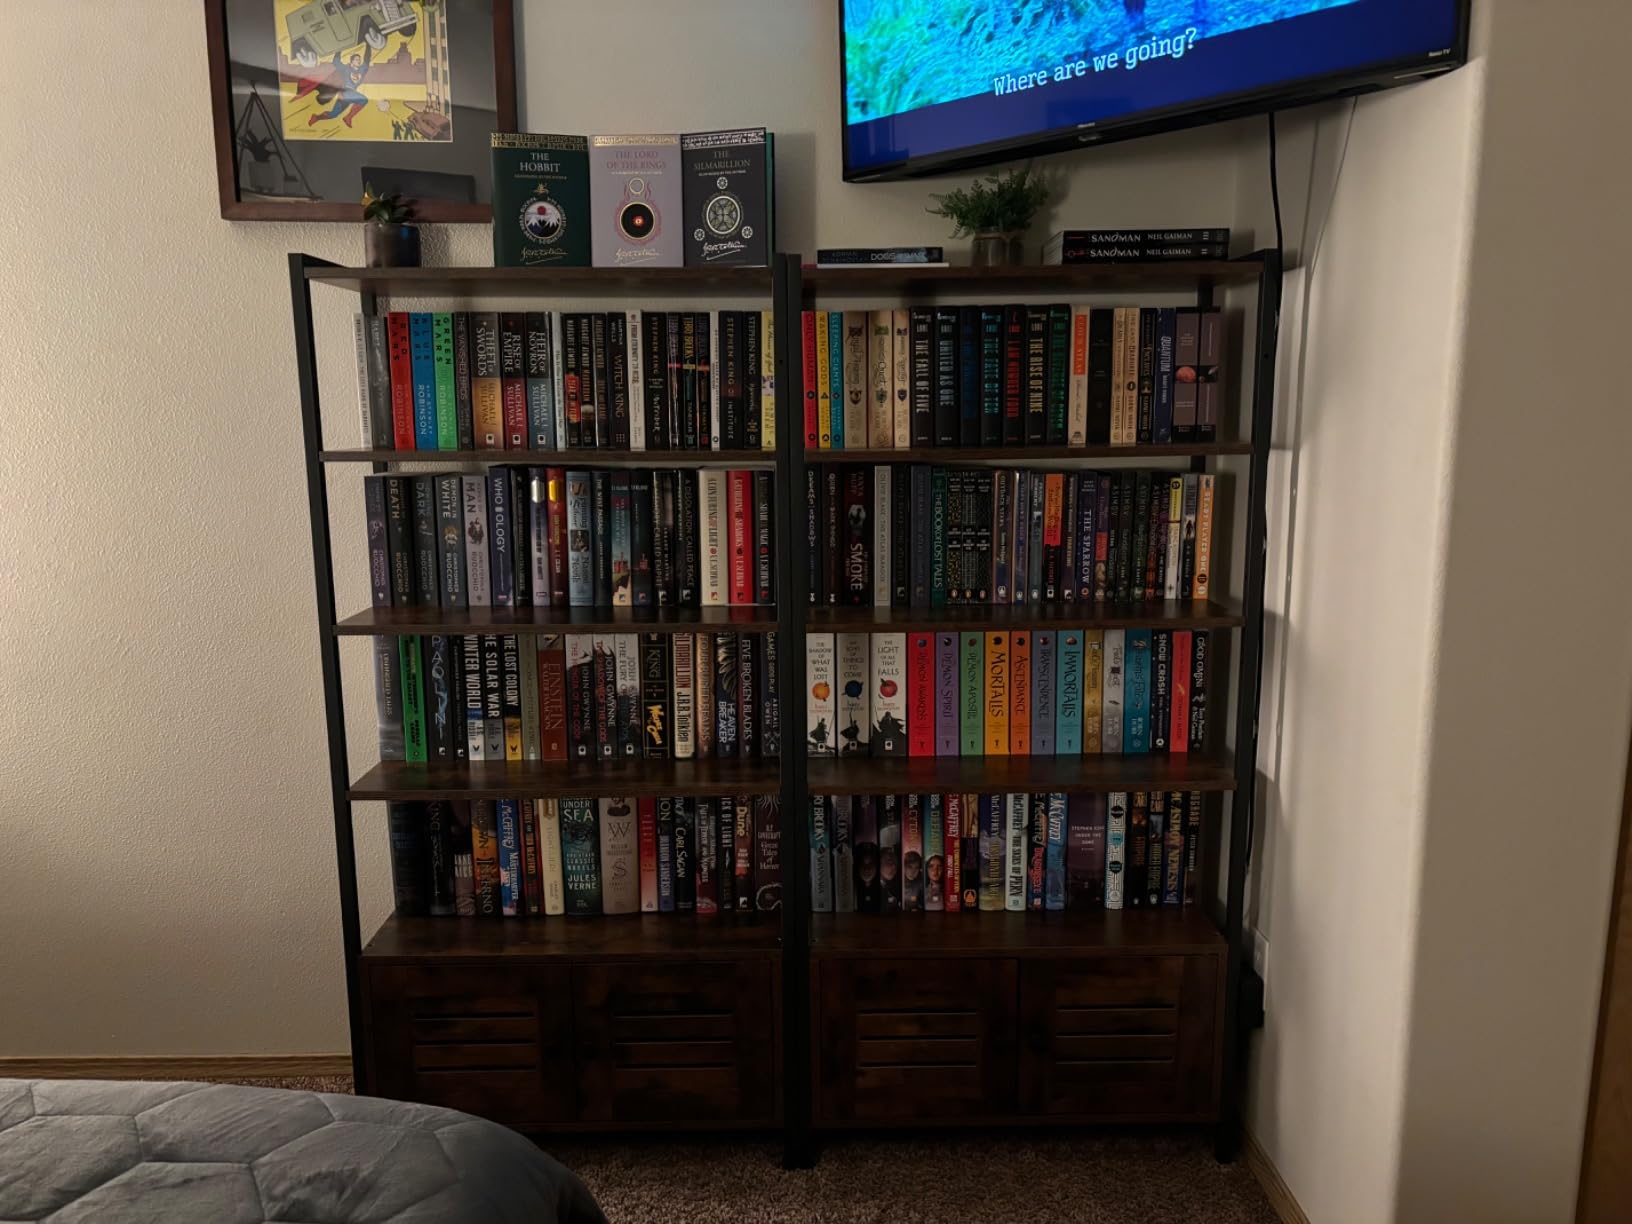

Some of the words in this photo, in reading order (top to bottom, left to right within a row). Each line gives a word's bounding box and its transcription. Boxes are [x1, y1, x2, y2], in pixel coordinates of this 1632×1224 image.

[994, 72, 1048, 96] Where
[1053, 59, 1086, 79] are
[1093, 52, 1119, 72] we
[1125, 27, 1198, 70] going?
[520, 162, 560, 172] HOBBIT
[531, 152, 549, 160] THE
[607, 161, 619, 169] OF
[621, 161, 636, 169] THE
[640, 161, 667, 169] RINGS
[615, 150, 632, 158] THE
[635, 150, 657, 158] LORD
[694, 159, 750, 170] SILMARILLION
[1091, 234, 1141, 242] SANDMAN
[1090, 249, 1140, 257] SANDMAN
[443, 317, 451, 364] GREEN
[486, 329, 495, 365] THEFT
[512, 335, 520, 358] RISE
[536, 332, 546, 360] HEIR
[831, 314, 839, 354] SLEEPING
[916, 339, 928, 356] THE
[984, 338, 998, 354] THE
[1030, 338, 1043, 354] THE
[476, 328, 487, 376] SWORDS
[503, 332, 513, 373] EMPIRE
[514, 359, 520, 369] OF
[528, 331, 537, 374] NOVRON
[940, 340, 953, 371] UNITED
[1160, 336, 1171, 372] QUANTUM
[539, 362, 545, 372] OF
[614, 355, 624, 389] WITCH
[916, 359, 928, 378] FALL
[940, 375, 953, 386] AS
[984, 359, 998, 378] FATE
[1030, 357, 1043, 376] RISE
[916, 381, 929, 391] OF
[940, 389, 954, 406] ONE
[985, 384, 998, 392] OF
[1030, 380, 1043, 390] OF
[418, 385, 426, 434] ROBINSON
[514, 384, 522, 422] MICHAEL
[532, 386, 540, 425] SULLIVAN
[615, 393, 624, 418] KING
[916, 395, 929, 413] FIVE
[985, 397, 998, 414] TEN
[1030, 392, 1043, 413] NINE
[389, 480, 400, 519] DEATH
[416, 482, 425, 517] DARK
[442, 480, 451, 518] WHITE
[466, 483, 476, 513] MAN
[494, 478, 503, 504] WHO
[452, 510, 457, 518] IN
[934, 507, 943, 531] BOOK
[1083, 510, 1091, 532] THE
[496, 514, 504, 553] OLOGY
[936, 532, 942, 541] OF
[1201, 522, 1209, 552] PLAYER
[686, 536, 694, 563] CALLED
[934, 542, 943, 561] LOST
[1082, 536, 1090, 584] SPARROW
[850, 544, 863, 592] SMOKE
[934, 563, 942, 588] TALES
[503, 634, 515, 649] THE
[742, 640, 751, 660] FIVE
[767, 632, 776, 660] GAMES
[1159, 633, 1167, 661] SNOW
[504, 652, 516, 671] LOST
[605, 656, 614, 681] JOHN
[628, 657, 636, 681] JOHN
[648, 649, 661, 678] KING
[878, 668, 899, 676] FALLS
[942, 653, 952, 686] DEMON
[968, 653, 976, 682] DEMON
[466, 674, 482, 708] WORLD
[505, 675, 518, 707] COLONY
[582, 666, 590, 689] JOHN
[741, 662, 751, 701] BROKEN
[989, 651, 1006, 717] MORTALIS
[1015, 656, 1028, 714] ASCENDANCE
[1038, 649, 1051, 718] TRANSCENDENCE
[1062, 651, 1080, 718] IMMORTALIS
[1158, 663, 1166, 695] CRASH
[548, 664, 563, 729] EINSTEIN
[607, 685, 615, 727] GWYNNE
[629, 686, 637, 727] GWYNNE
[941, 690, 953, 718] SPIRIT
[583, 692, 591, 731] GWYNNE
[719, 701, 727, 743] BREAKER
[743, 705, 752, 740] BLADES
[564, 809, 594, 822] SEA
[736, 806, 748, 836] Dune
[947, 799, 959, 838] McCAFFREY
[991, 794, 1000, 836] McCAFFREY
[1013, 794, 1023, 831] McCAFFREY
[1170, 806, 1182, 846] ASIMOV
[675, 827, 685, 848] CARL
[1013, 836, 1021, 847] THE
[677, 850, 688, 878] SAGAN
[1012, 848, 1021, 865] SKIES
[1168, 849, 1180, 891] NEMESIS
[568, 874, 596, 882] JULES
[568, 882, 597, 890] VERNE
[1010, 875, 1022, 896] PERN
